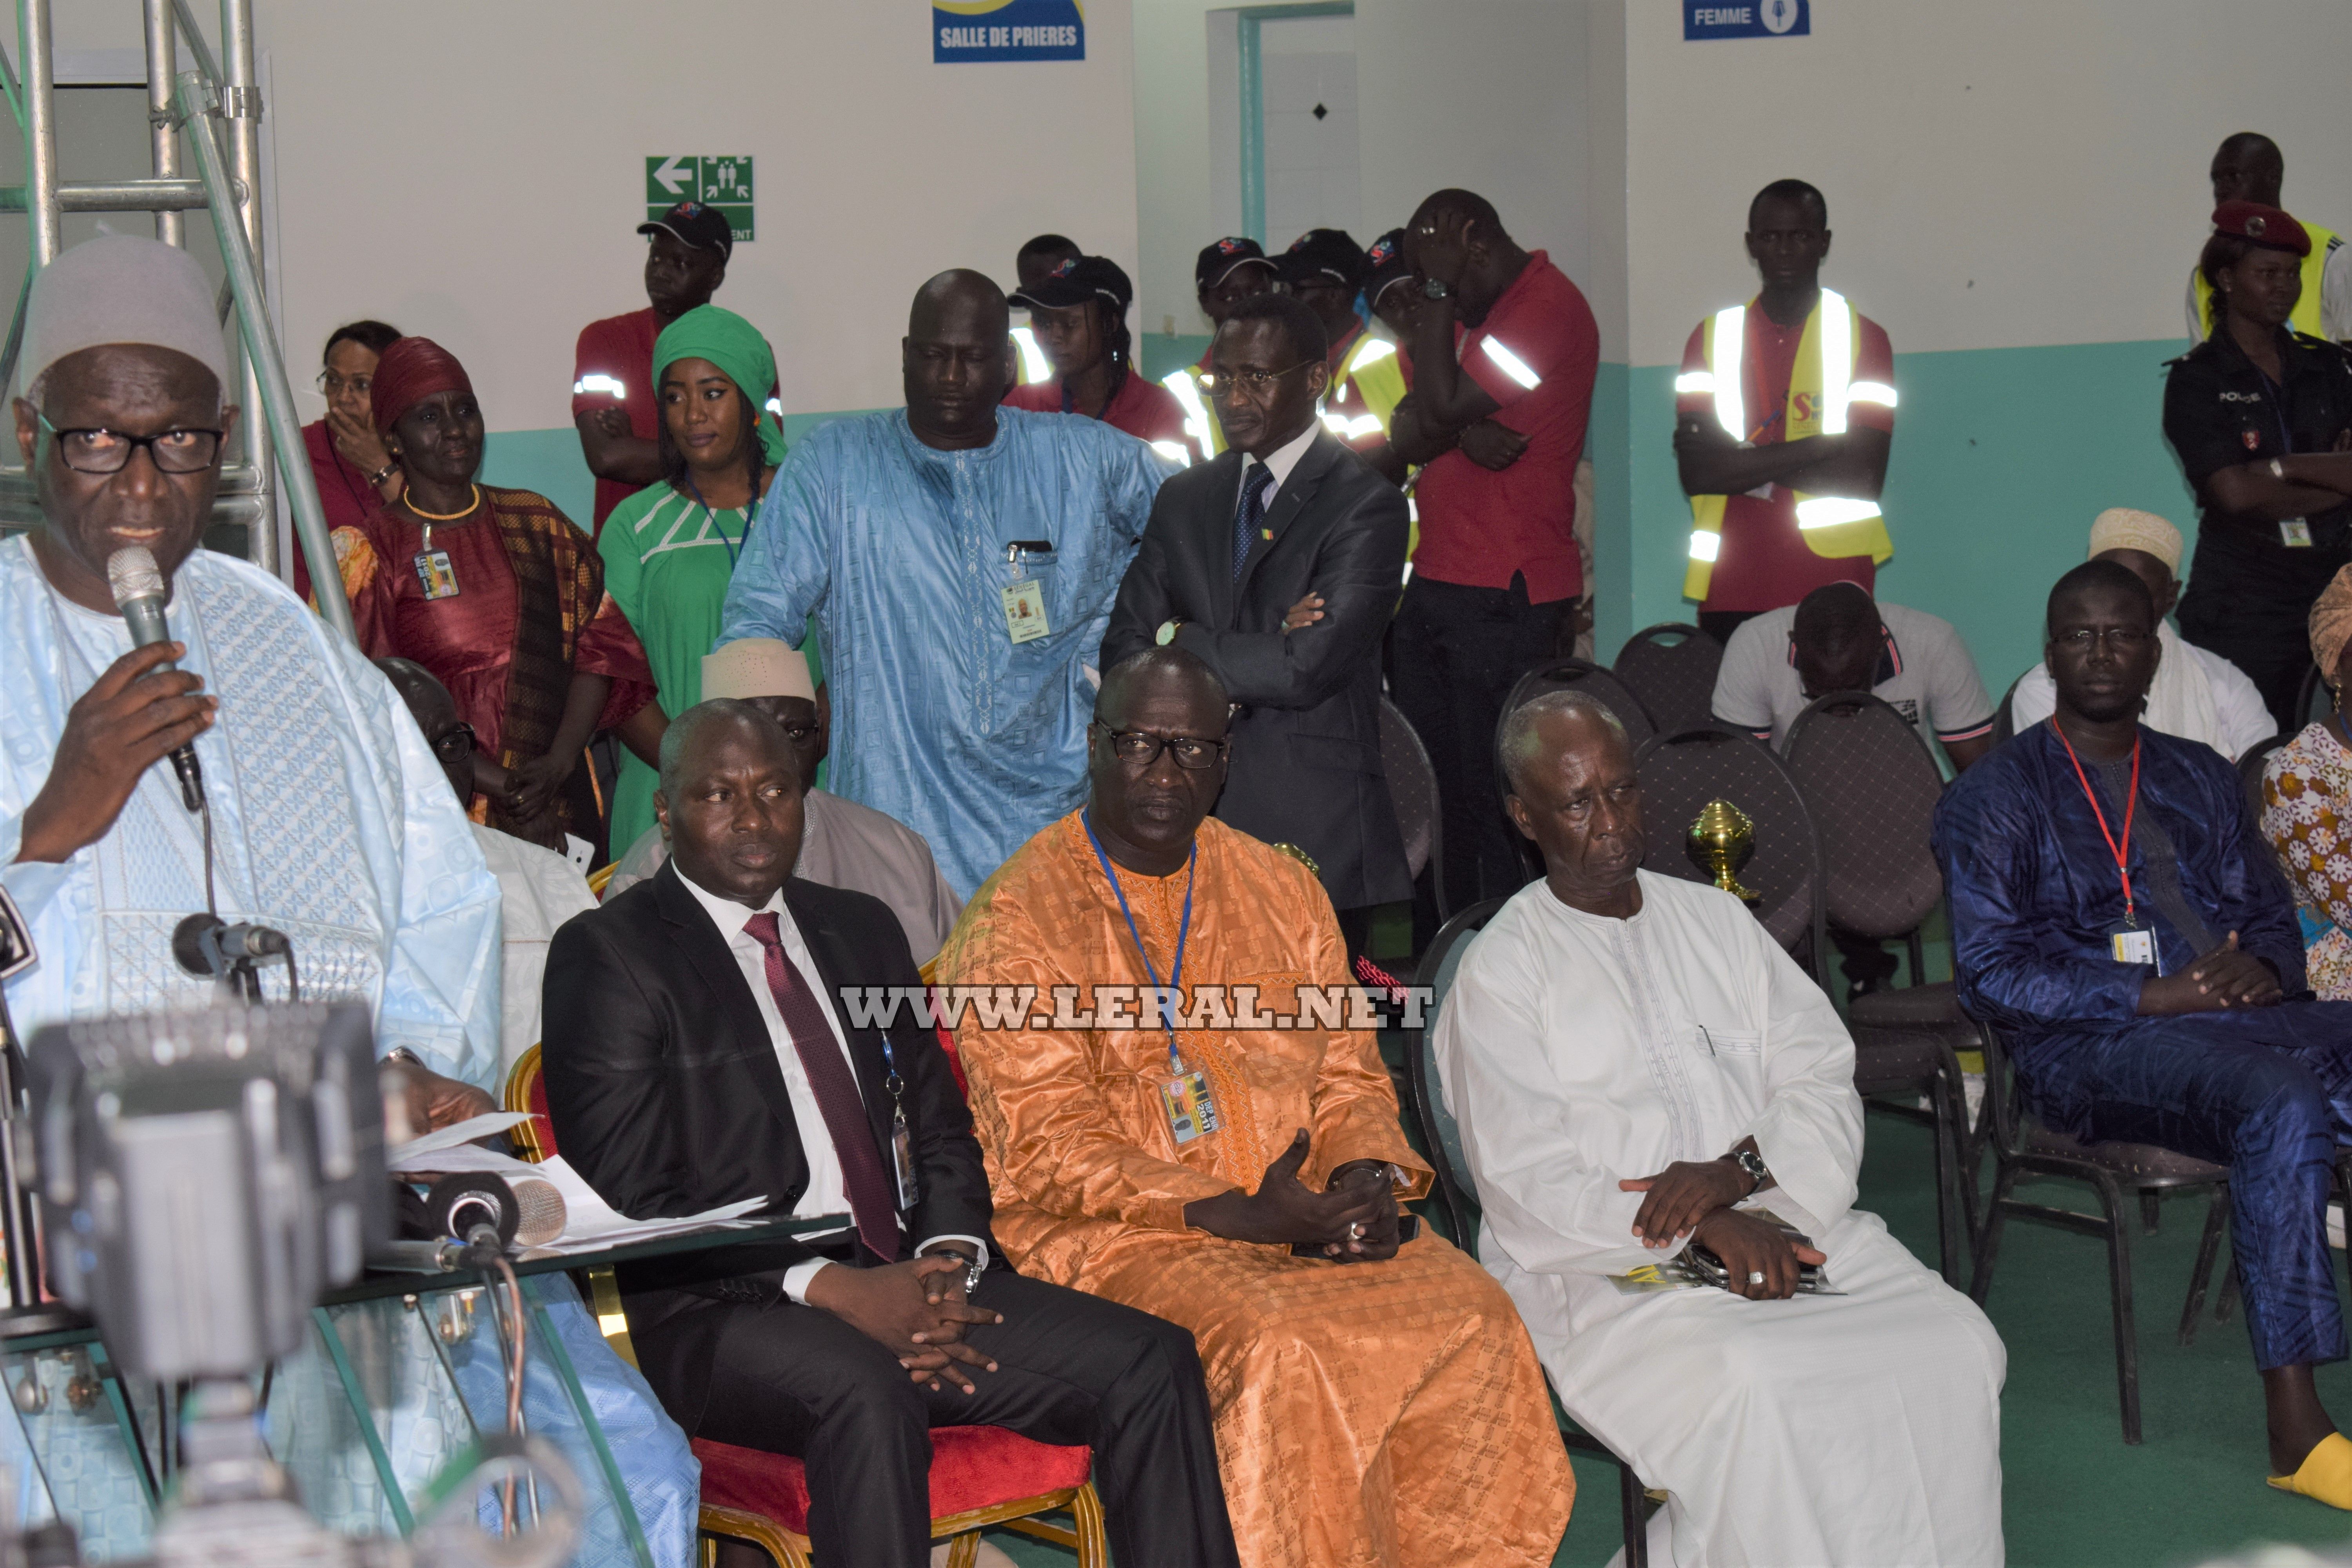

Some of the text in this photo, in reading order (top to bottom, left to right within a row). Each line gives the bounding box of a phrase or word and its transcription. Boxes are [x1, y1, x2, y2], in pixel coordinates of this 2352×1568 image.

[1695, 7, 1751, 25] FEMME
[941, 25, 1076, 48] SALLE DE PRIERES
[2219, 391, 2261, 404] POLCE
